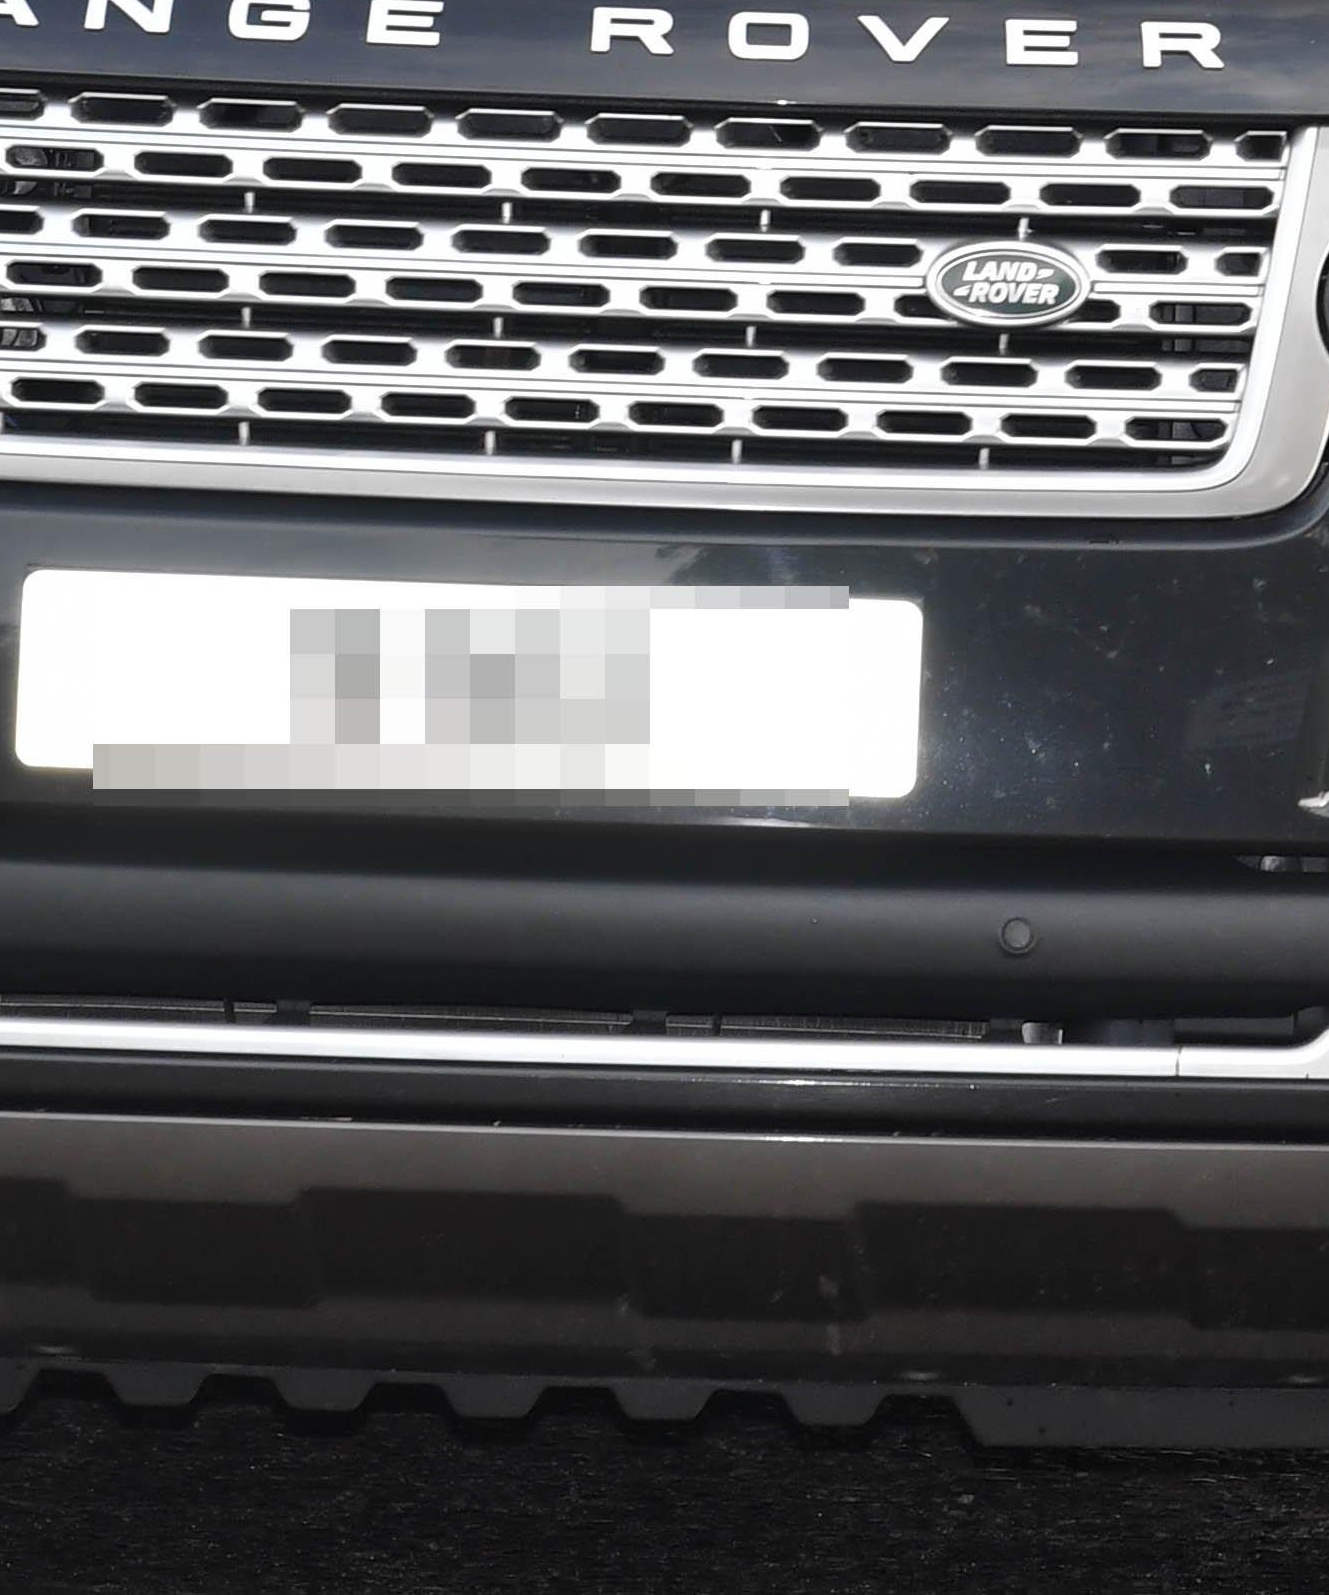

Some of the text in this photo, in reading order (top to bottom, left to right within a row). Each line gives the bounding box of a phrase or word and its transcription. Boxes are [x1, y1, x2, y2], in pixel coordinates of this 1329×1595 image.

[590, 6, 1226, 69] ROVER
[962, 261, 1039, 282] LAND
[968, 282, 1060, 305] ROVER
